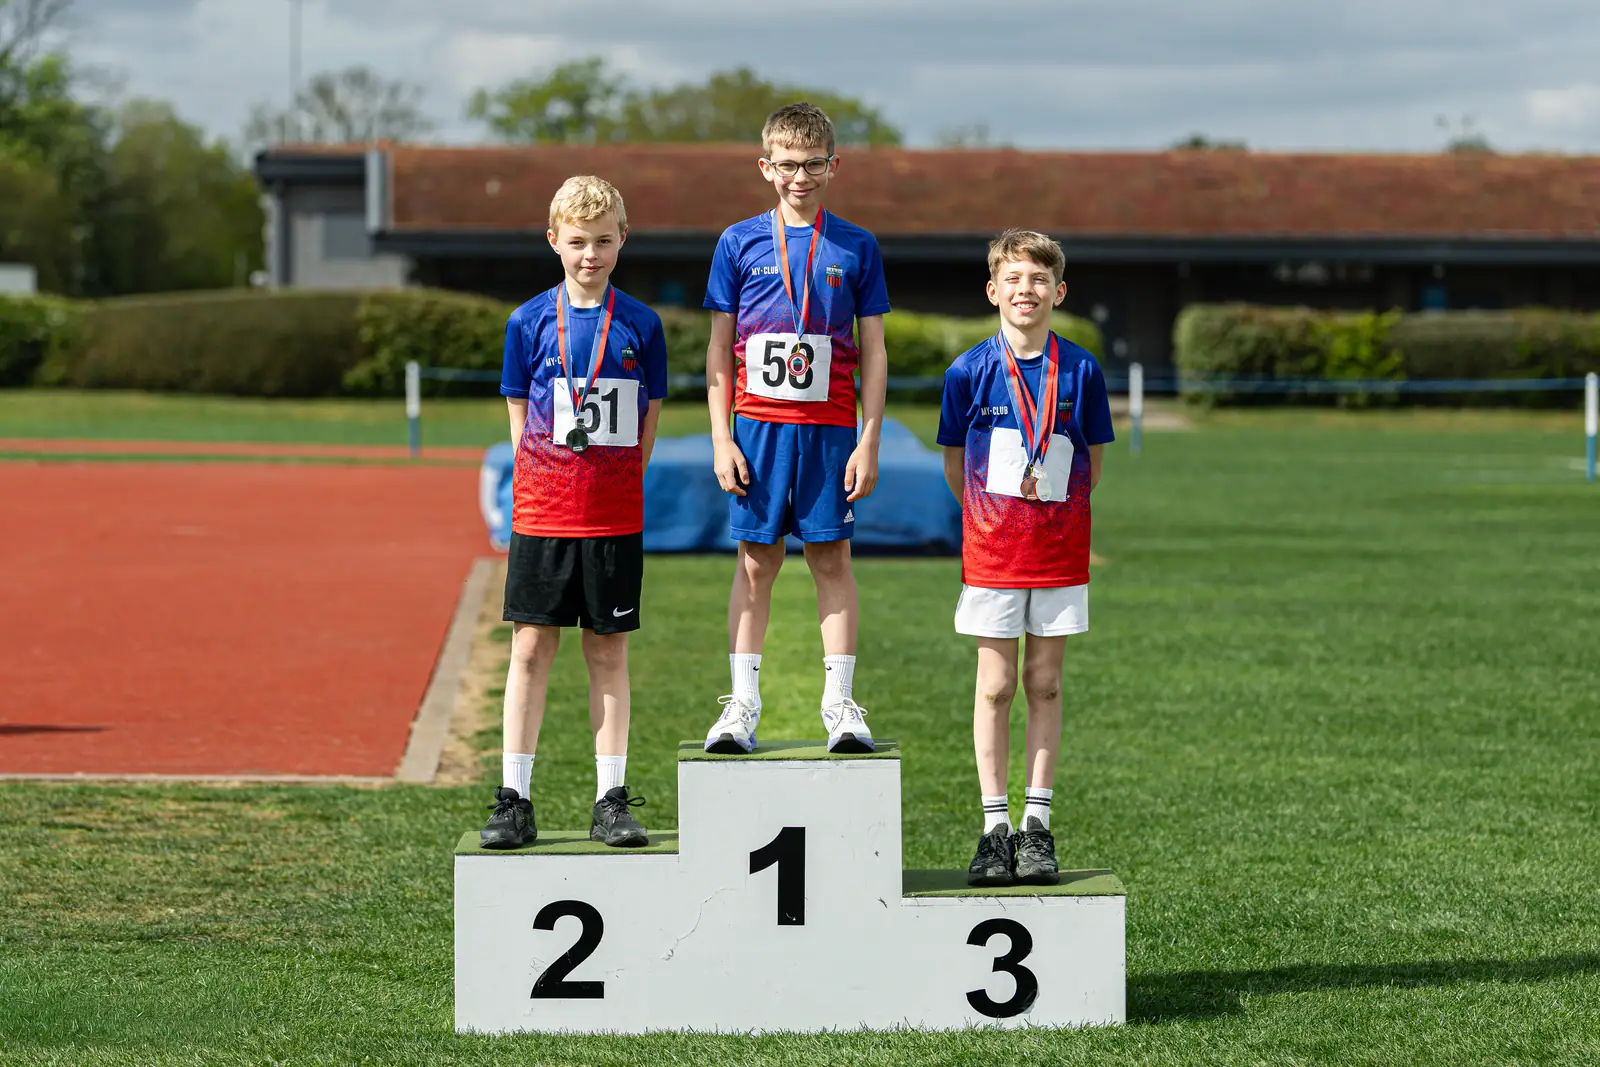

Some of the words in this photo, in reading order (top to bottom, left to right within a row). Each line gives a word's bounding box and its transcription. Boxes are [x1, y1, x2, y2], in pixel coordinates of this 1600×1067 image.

[577, 387, 618, 434] 51
[762, 340, 814, 390] 58
[750, 827, 806, 926] 1
[531, 900, 605, 999] 2
[966, 918, 1038, 1018] 3
